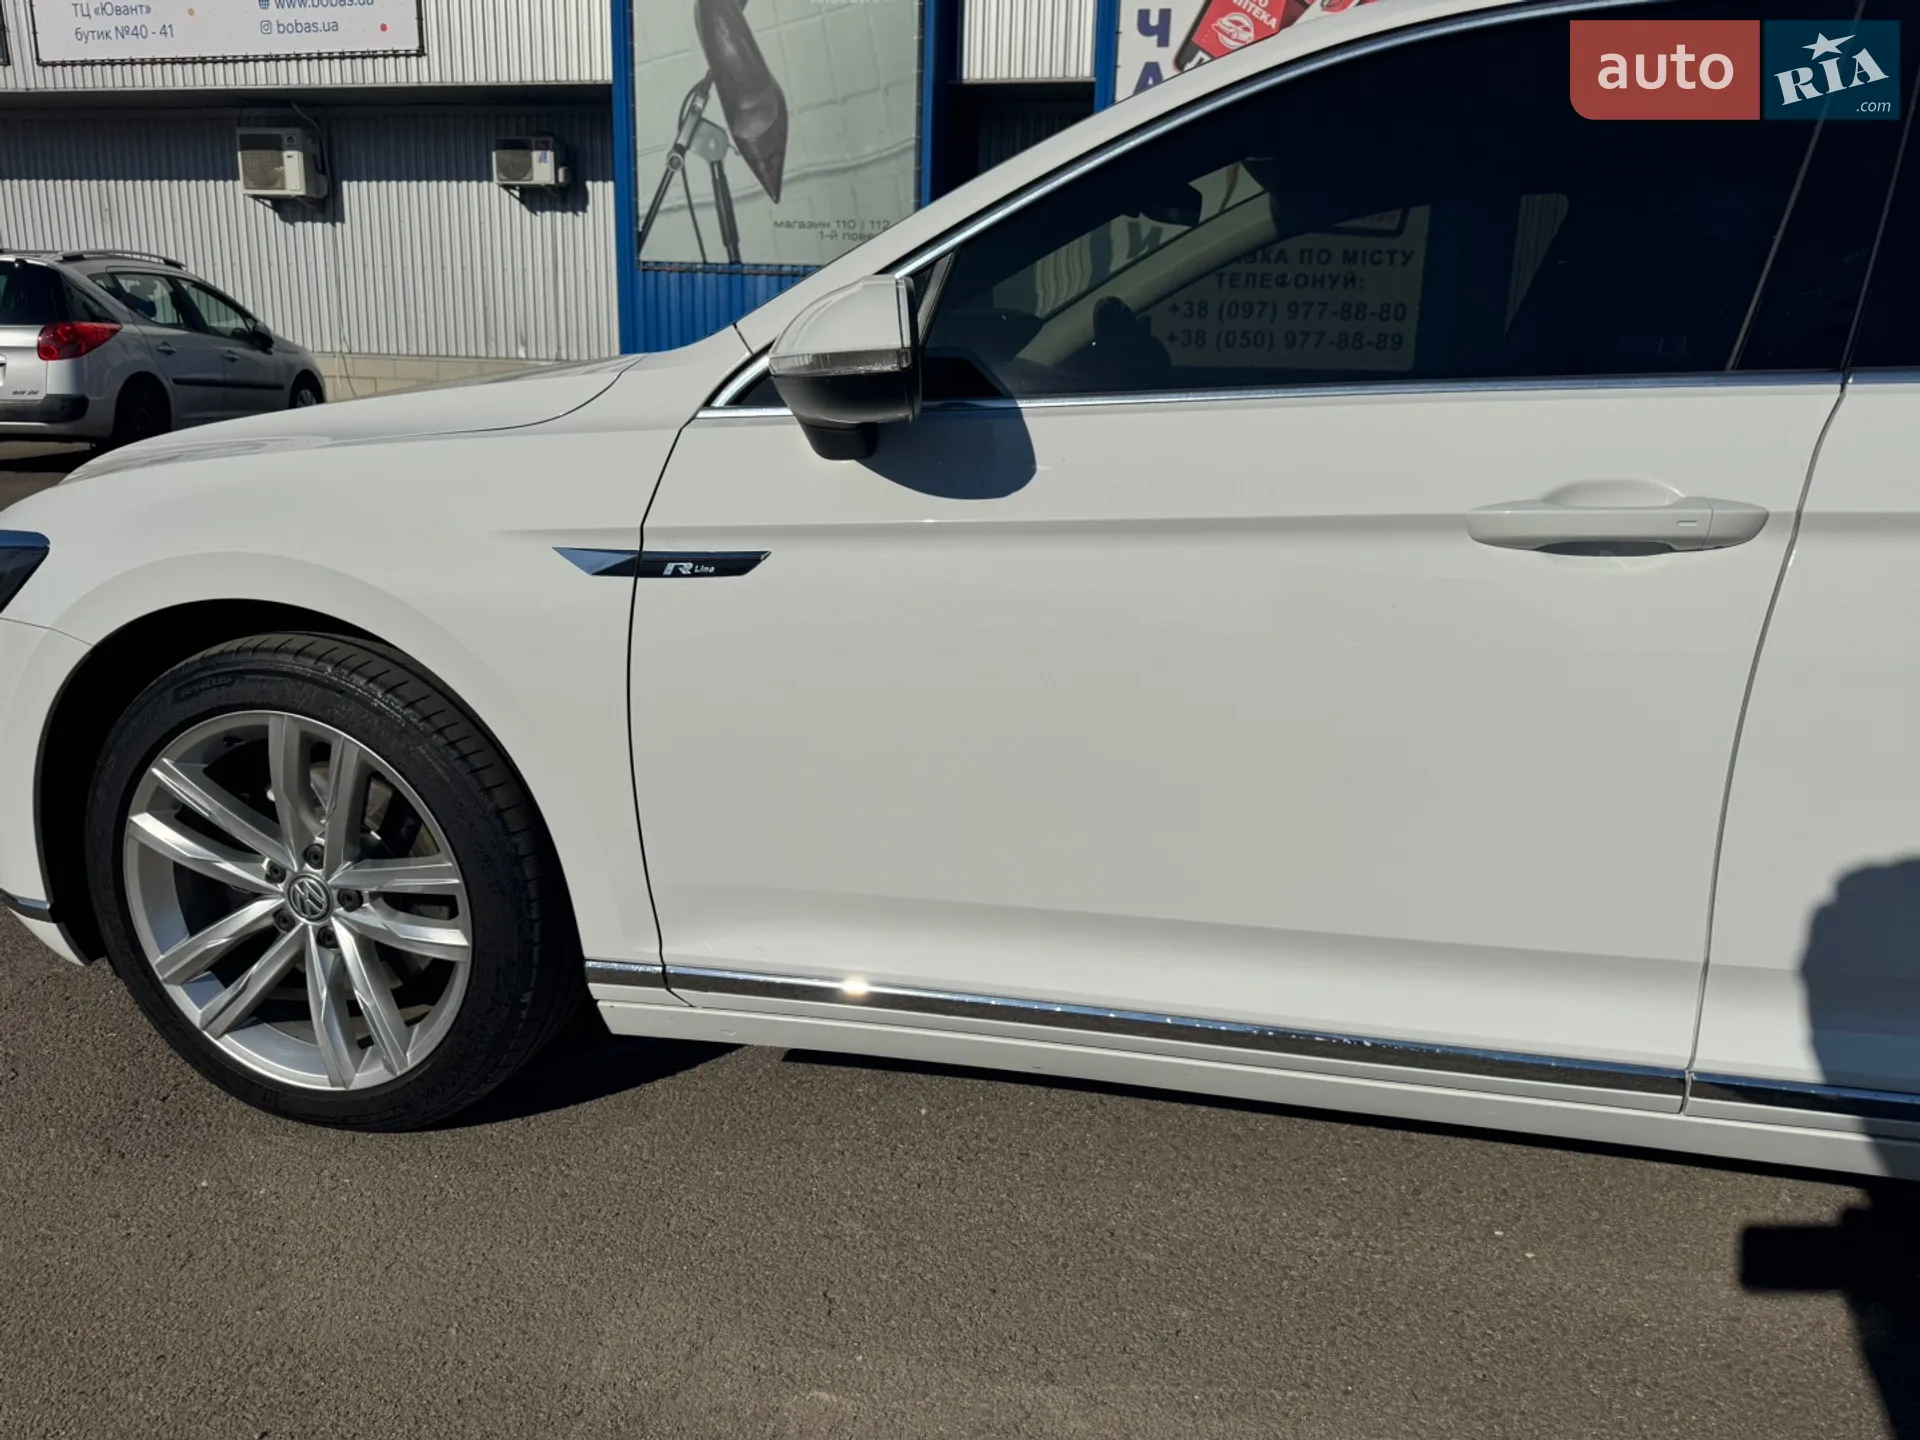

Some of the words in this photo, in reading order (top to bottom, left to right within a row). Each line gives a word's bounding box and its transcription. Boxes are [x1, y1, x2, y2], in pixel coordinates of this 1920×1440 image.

[72, 3, 91, 19] ТЦ
[94, 1, 151, 16] «Ювант»
[75, 27, 112, 44] бутик
[115, 24, 148, 39] №40
[159, 24, 174, 38] 41
[276, 20, 339, 34] bobas.ua
[774, 220, 830, 229] магазин
[836, 220, 856, 230] 110
[1299, 249, 1333, 266] ПО
[1342, 249, 1416, 267] МІСТУ
[1216, 271, 1365, 291] ТЕЛЕФОНУЙ:
[1168, 300, 1209, 319] +38
[1218, 300, 1278, 324] (097)
[1287, 301, 1407, 322] 977-88-80
[1166, 328, 1207, 348] +38
[1215, 329, 1275, 353] (050)
[1284, 330, 1405, 352] 977-88-89
